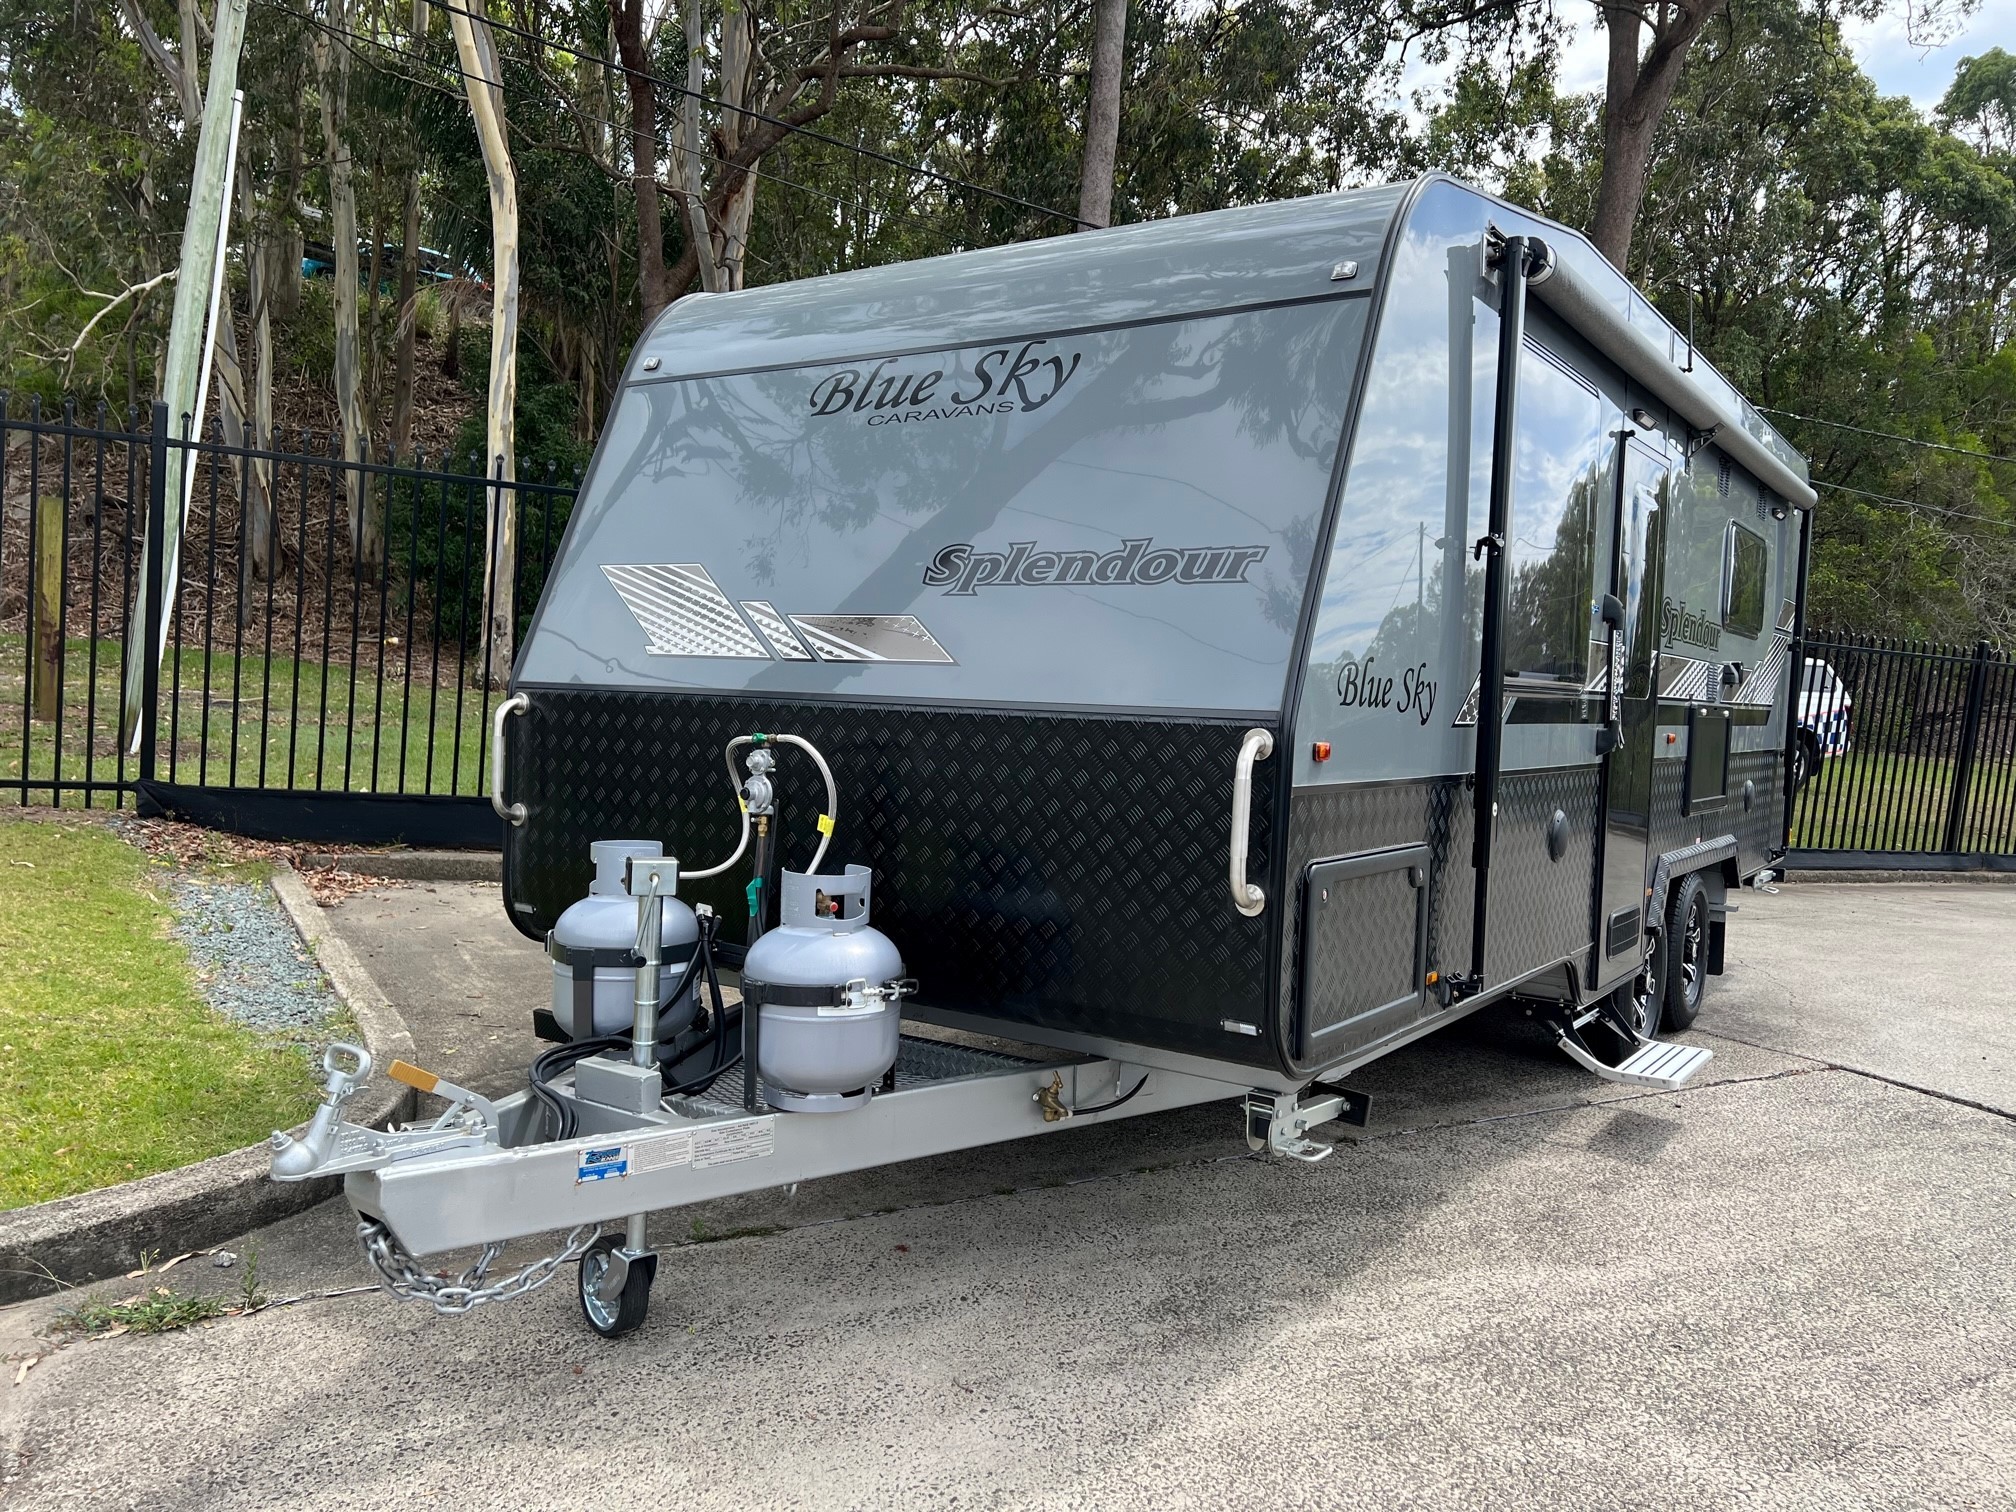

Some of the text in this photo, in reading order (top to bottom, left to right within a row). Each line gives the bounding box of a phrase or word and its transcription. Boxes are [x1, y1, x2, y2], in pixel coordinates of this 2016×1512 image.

[809, 340, 1081, 417] Blue Sky
[867, 401, 1014, 426] CARAVANS
[922, 537, 1270, 596] Splendour
[1660, 596, 1721, 652] Splendour
[1337, 656, 1436, 726] Blue Sky
